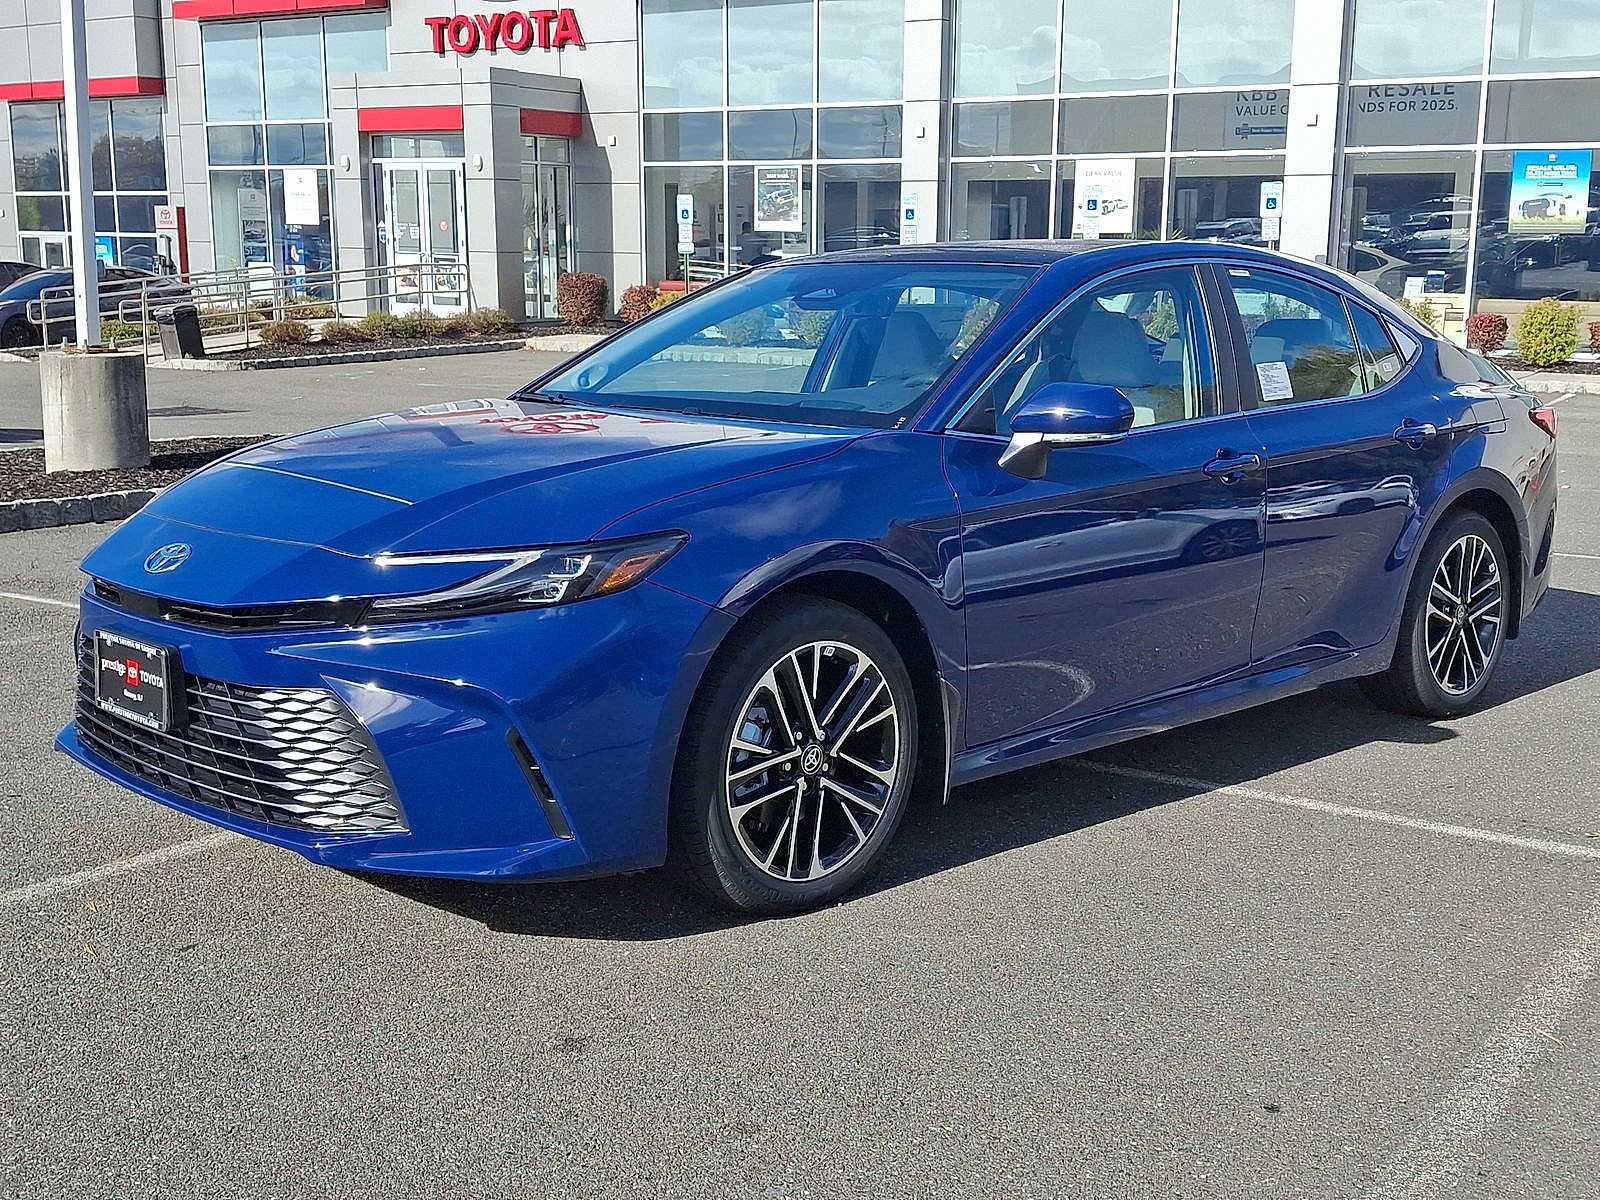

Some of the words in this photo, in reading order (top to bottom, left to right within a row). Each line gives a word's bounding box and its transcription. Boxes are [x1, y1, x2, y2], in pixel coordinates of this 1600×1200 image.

[424, 8, 585, 54] TOYOTA
[1368, 84, 1455, 98] RESALE
[1236, 105, 1276, 116] VALUE
[1389, 100, 1416, 112] FOR
[1421, 99, 1458, 111] 2025.
[101, 658, 126, 677] prestige
[139, 670, 164, 689] TOYOTA
